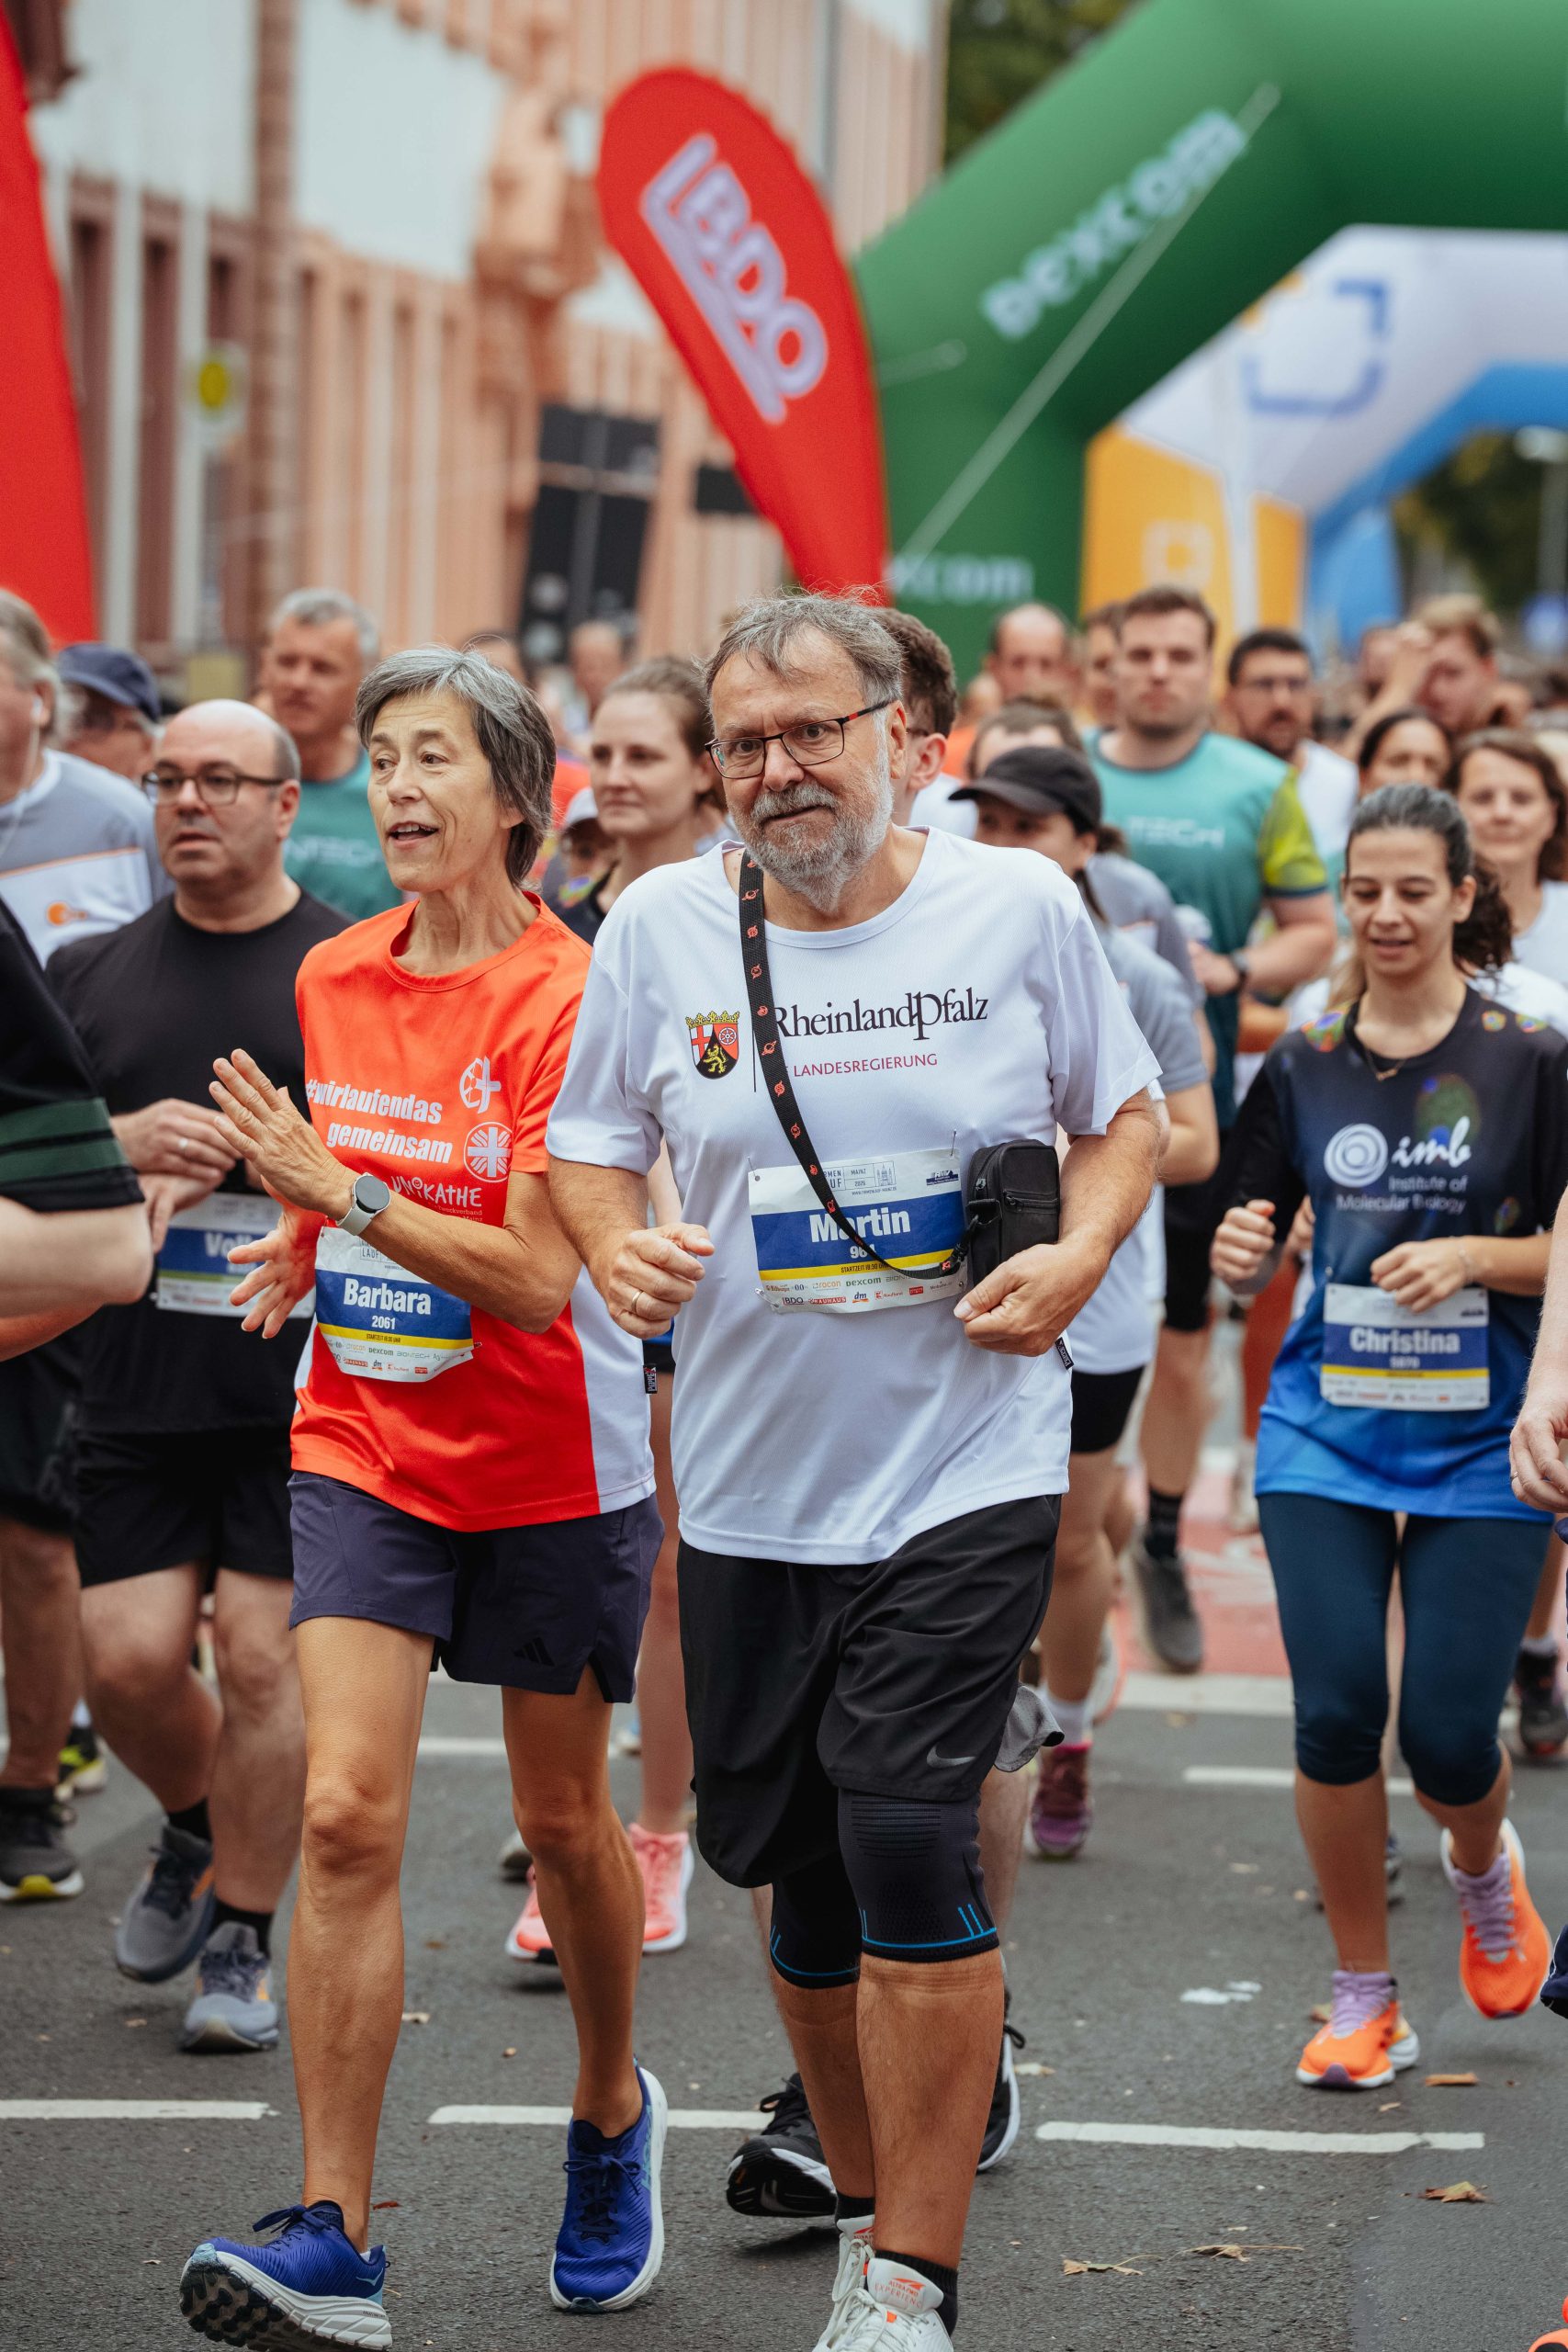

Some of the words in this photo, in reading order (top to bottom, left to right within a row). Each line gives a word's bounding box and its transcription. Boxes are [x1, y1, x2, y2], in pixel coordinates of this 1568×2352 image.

[794, 1053, 938, 1077] LANDESREGIERUNG
[306, 1079, 443, 1125] #wirlaufendas
[326, 1122, 453, 1164] gemeinsam
[1391, 1115, 1472, 1168] imb
[851, 1168, 866, 1176] MAINZ
[829, 1178, 842, 1189] UF
[1388, 1175, 1447, 1192] Institute
[1449, 1175, 1469, 1192] of
[1336, 1193, 1411, 1212] Molecular
[840, 1263, 864, 1273] STARTZEIT
[344, 1278, 431, 1315] Barbara
[853, 1292, 867, 1300] dm
[371, 1315, 396, 1330] 2061
[1348, 1327, 1461, 1353] Christina
[874, 2282, 923, 2309] EXPERIENC
